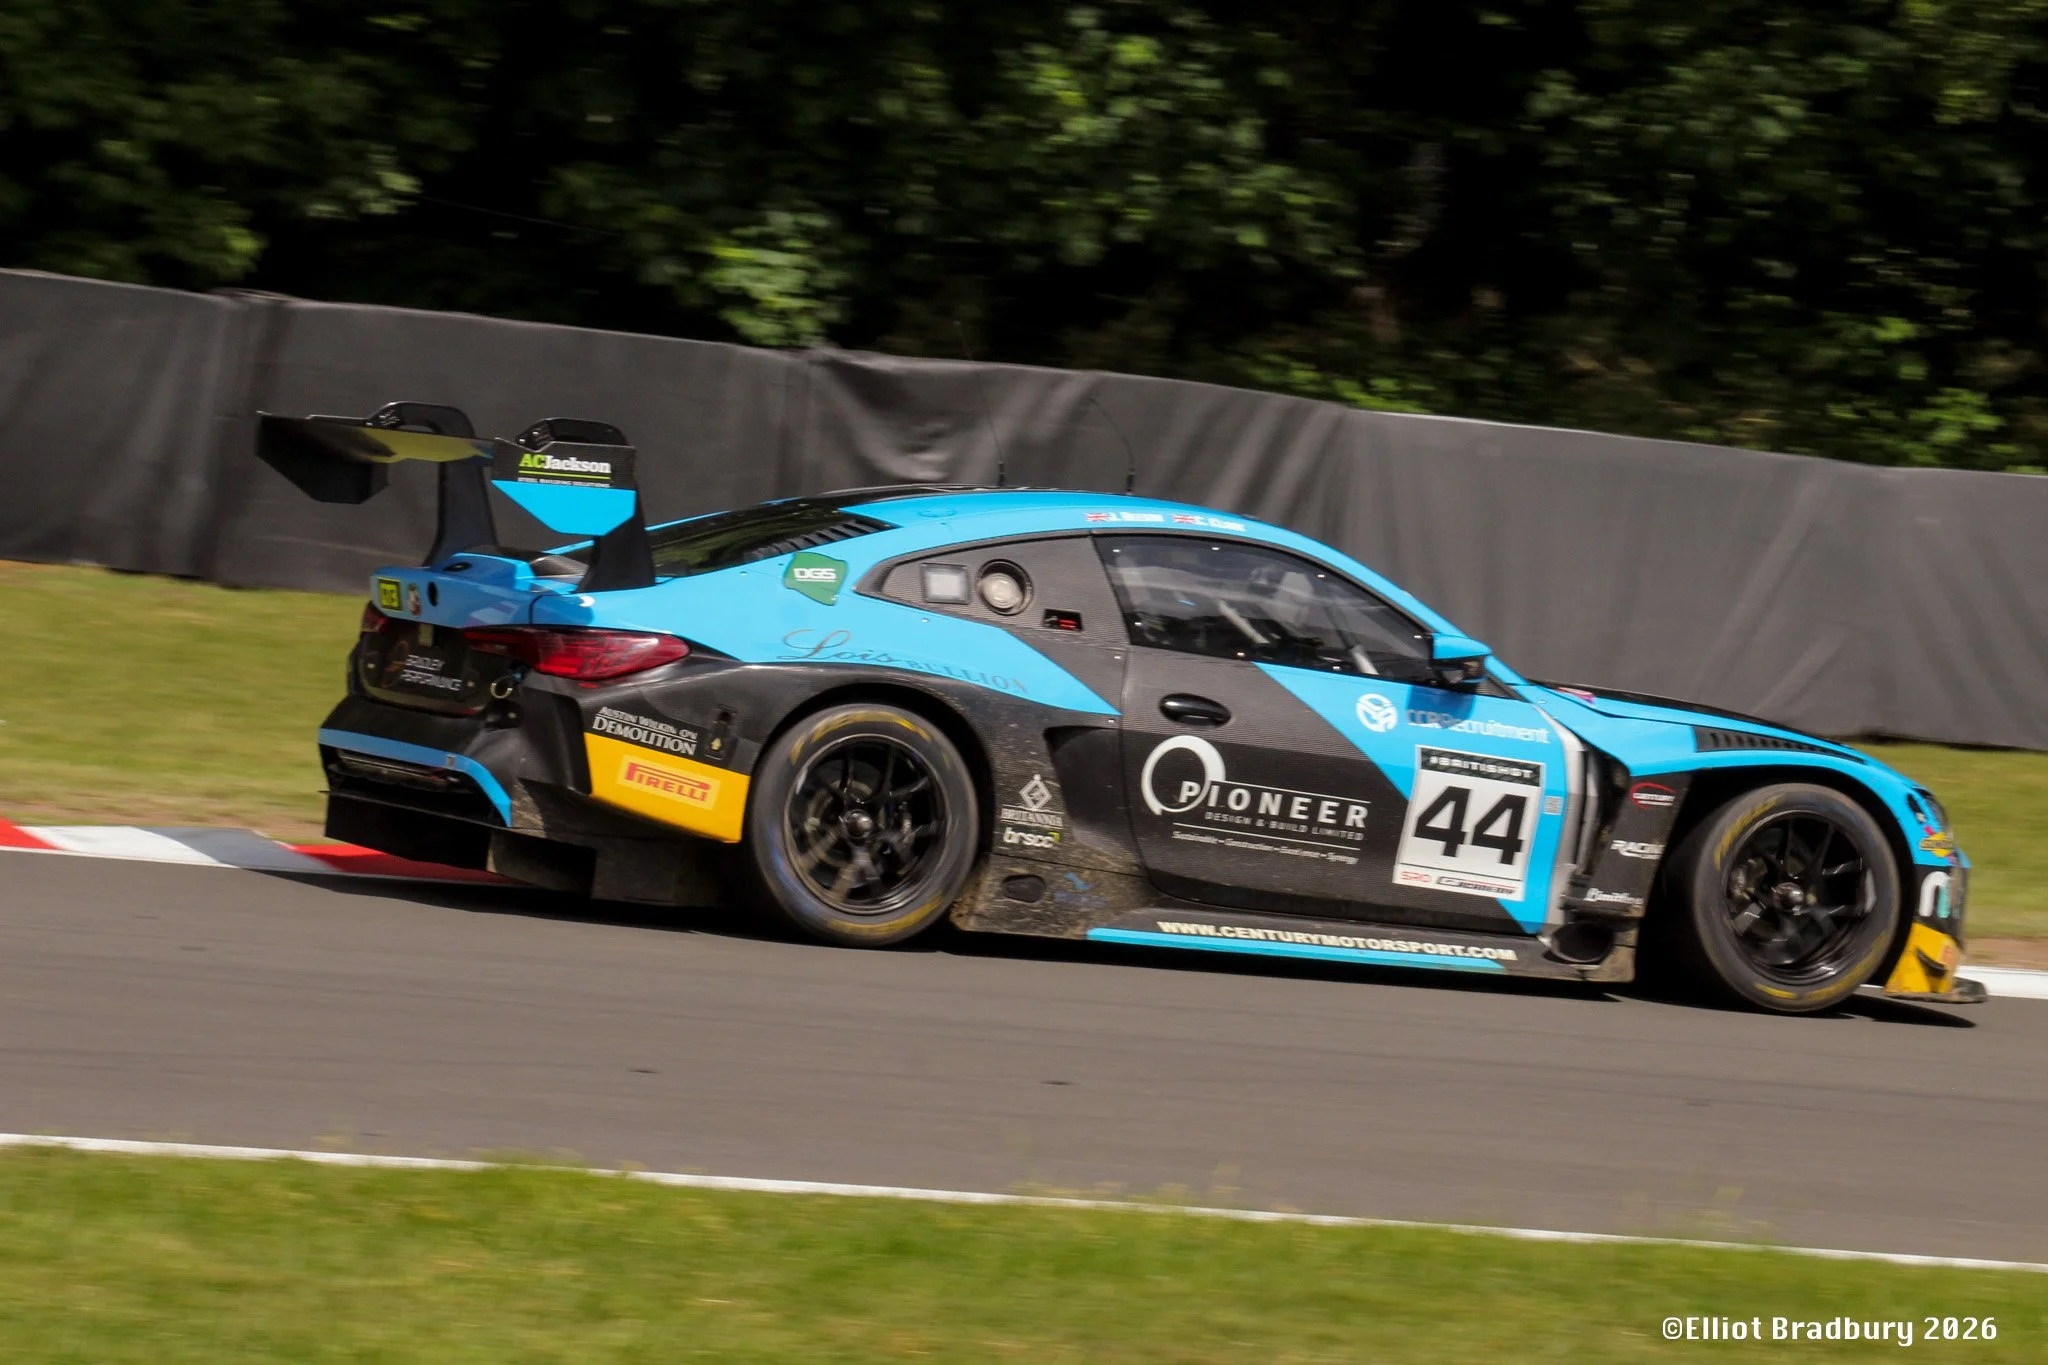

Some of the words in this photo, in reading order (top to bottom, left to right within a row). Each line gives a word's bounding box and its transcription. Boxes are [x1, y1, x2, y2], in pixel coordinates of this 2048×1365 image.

[518, 453, 612, 474] ACJackson
[793, 567, 837, 580] DGS
[776, 628, 900, 663] Lois
[591, 715, 698, 756] DEMOLITION
[624, 761, 711, 802] PIRELLI
[1178, 781, 1368, 828] PIONEER
[1003, 827, 1055, 848] brscc
[1204, 811, 1252, 825] DESIGN
[1255, 817, 1265, 828] &
[1268, 820, 1309, 833] BUILD
[1311, 826, 1365, 841] LIMITED
[1411, 785, 1529, 866] 44
[1156, 921, 1519, 961] WWW.CENTURYMOTORSPORT.COM
